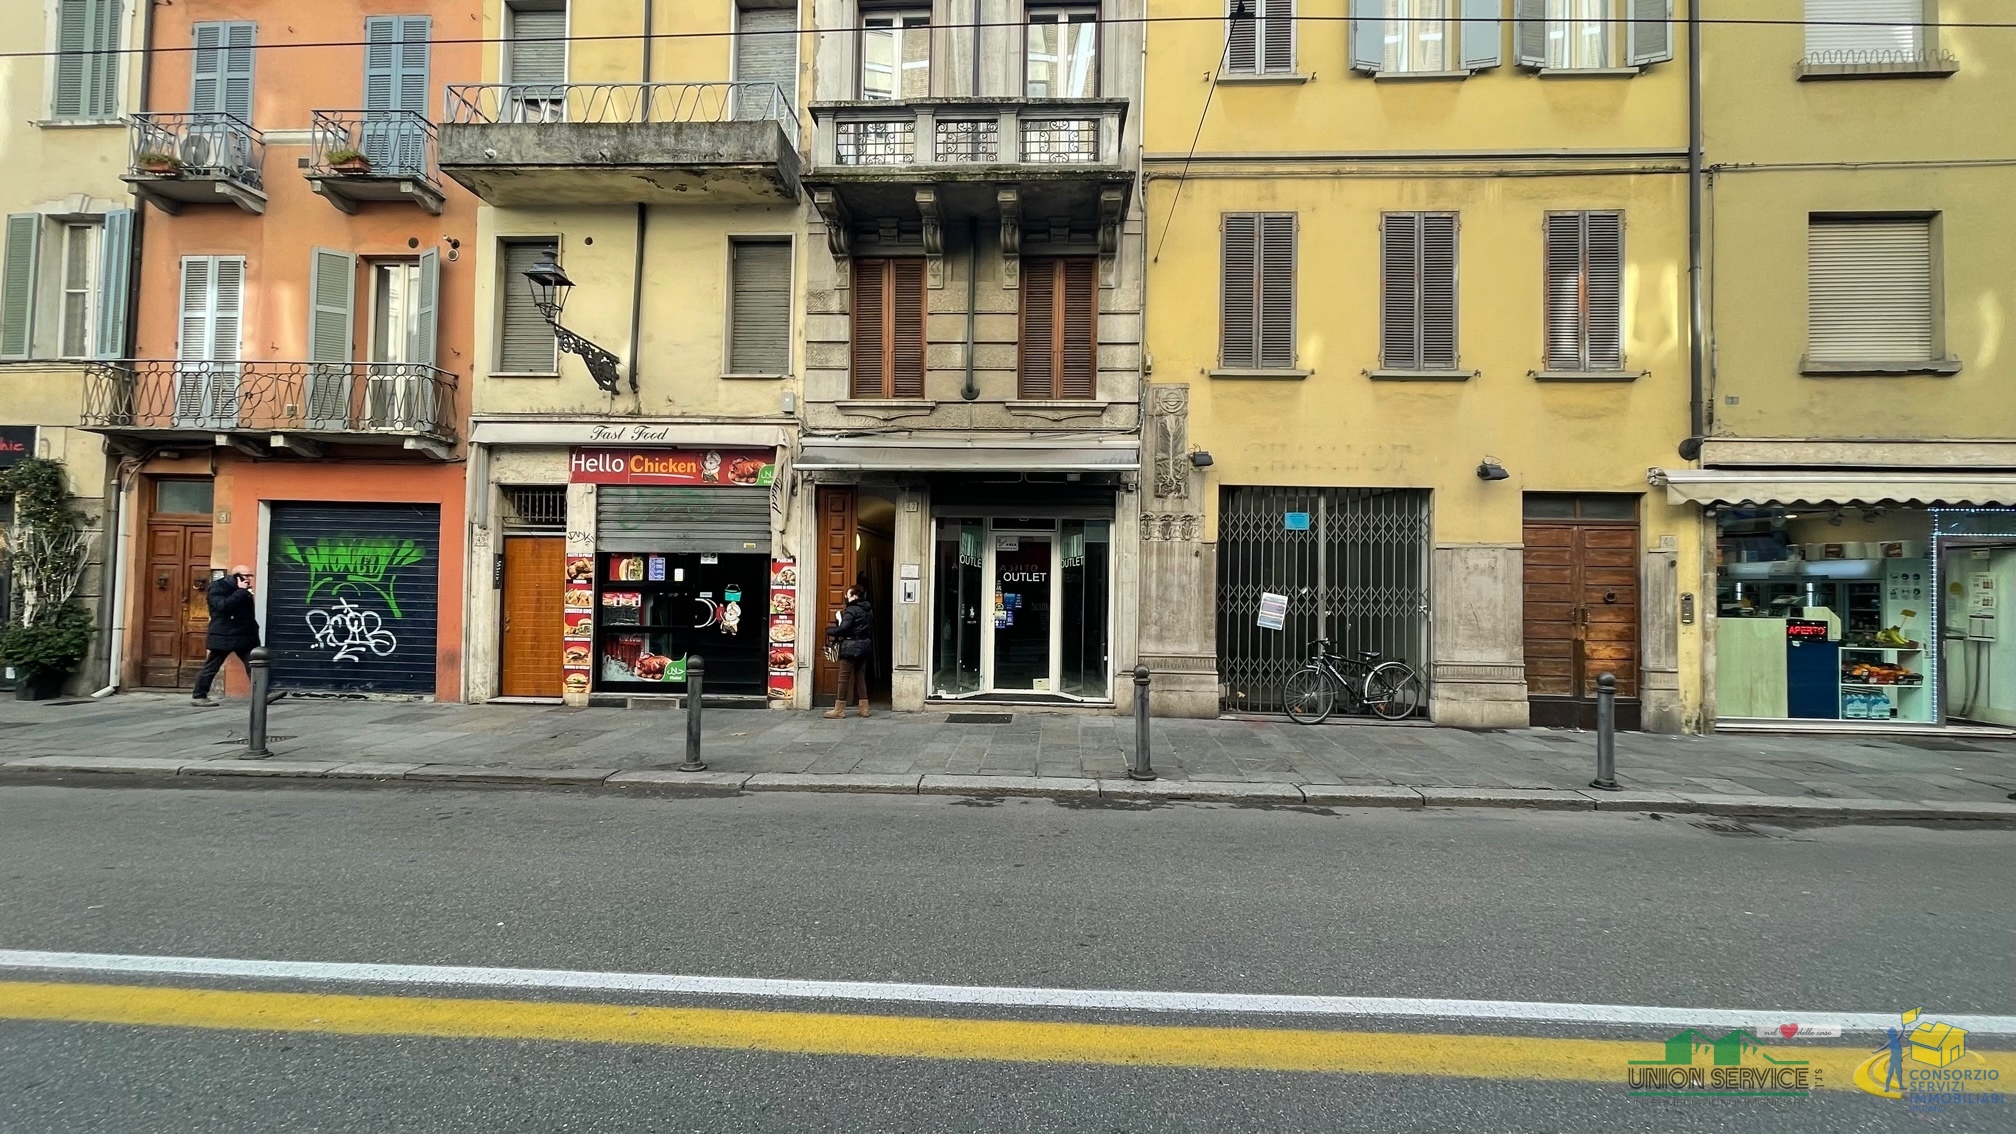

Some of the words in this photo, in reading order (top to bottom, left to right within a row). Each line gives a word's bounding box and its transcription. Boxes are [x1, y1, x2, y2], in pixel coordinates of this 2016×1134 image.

[590, 424, 626, 441] Fast
[630, 425, 669, 441] Food
[571, 453, 624, 473] Hello
[630, 455, 697, 473] Chicken
[960, 554, 982, 568] OUTLE
[1003, 572, 1048, 582] OUTLET
[1788, 626, 1826, 635] APERTO
